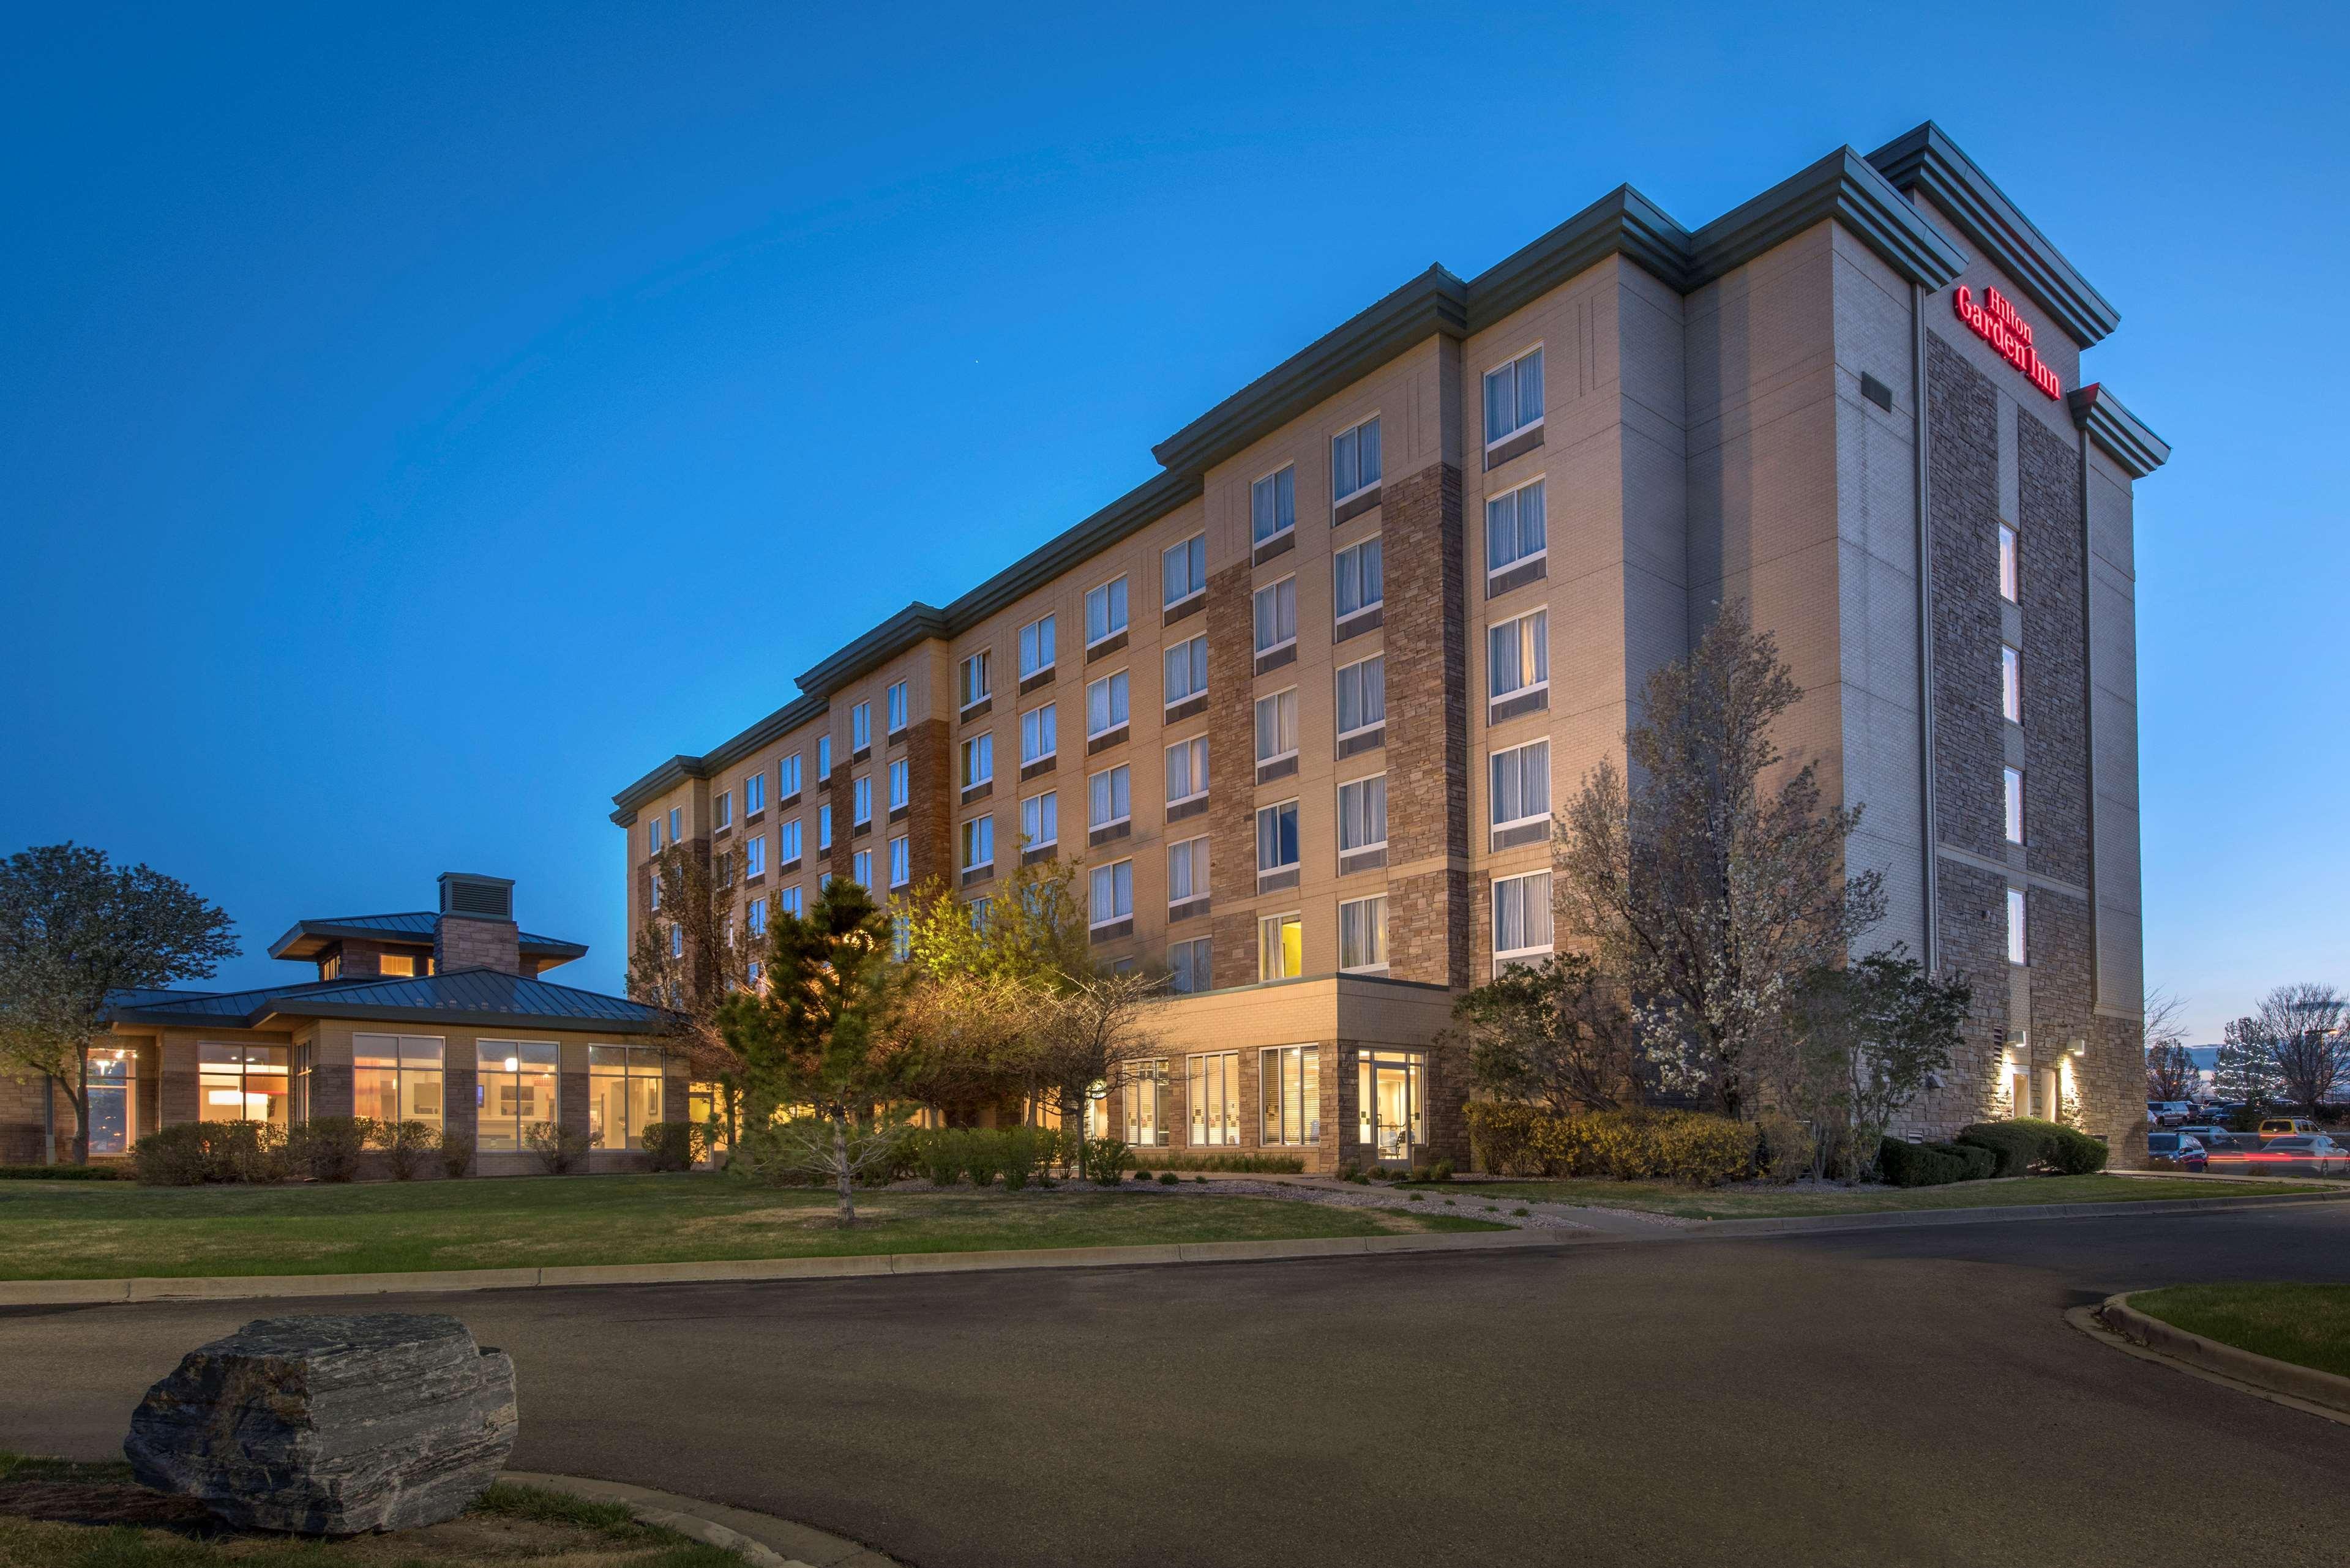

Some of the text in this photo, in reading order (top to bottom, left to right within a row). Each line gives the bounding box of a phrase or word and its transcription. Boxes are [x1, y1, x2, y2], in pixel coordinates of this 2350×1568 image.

[1956, 285, 2060, 400] Garden Inn
[1988, 286, 2032, 345] Hilton
